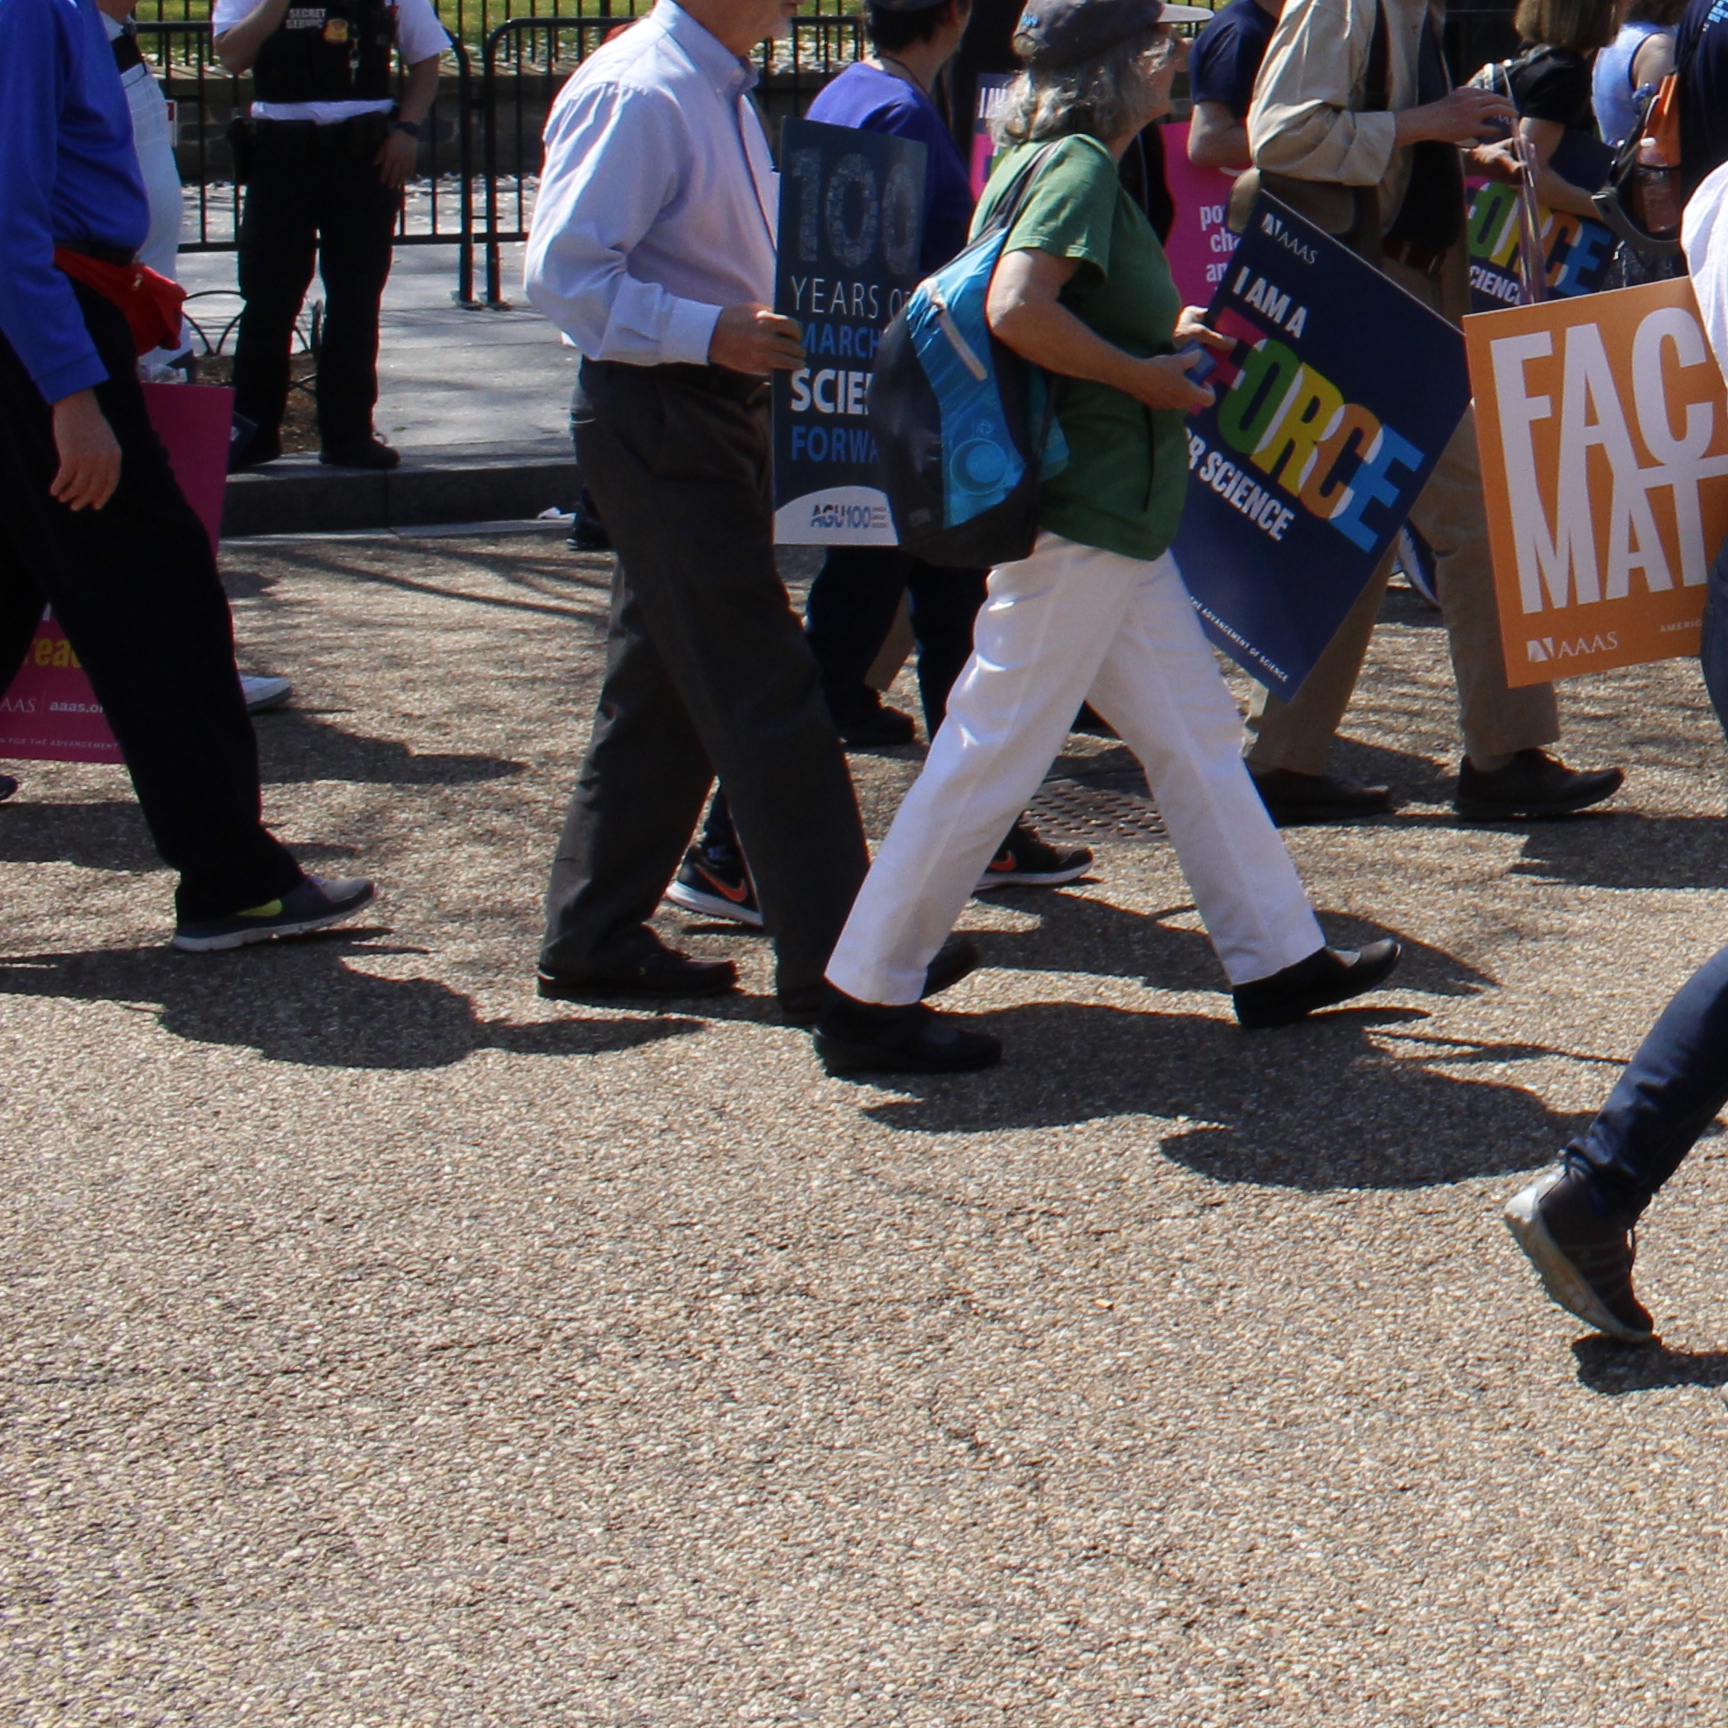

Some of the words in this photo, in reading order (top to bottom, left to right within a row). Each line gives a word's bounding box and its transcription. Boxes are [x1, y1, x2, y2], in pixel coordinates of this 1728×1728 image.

[289, 7, 327, 19] SECRET
[790, 146, 922, 275] 100
[1277, 228, 1318, 265] AAAS
[1464, 176, 1614, 298] ORCE
[791, 275, 880, 320] YEARS
[1232, 266, 1251, 296] I
[1244, 276, 1292, 324] AM
[1284, 305, 1308, 339] A
[1469, 264, 1522, 307] CIENC
[790, 368, 873, 415] SCIE
[1490, 306, 1717, 484] FAC
[791, 425, 879, 464] FORWA
[1186, 306, 1425, 554] FORCE
[1199, 450, 1295, 542] SCIENCE
[1557, 630, 1619, 659] AAAS
[1660, 619, 1703, 633] AMERIC
[0, 697, 37, 713] AAS
[50, 701, 104, 714] aaas.o
